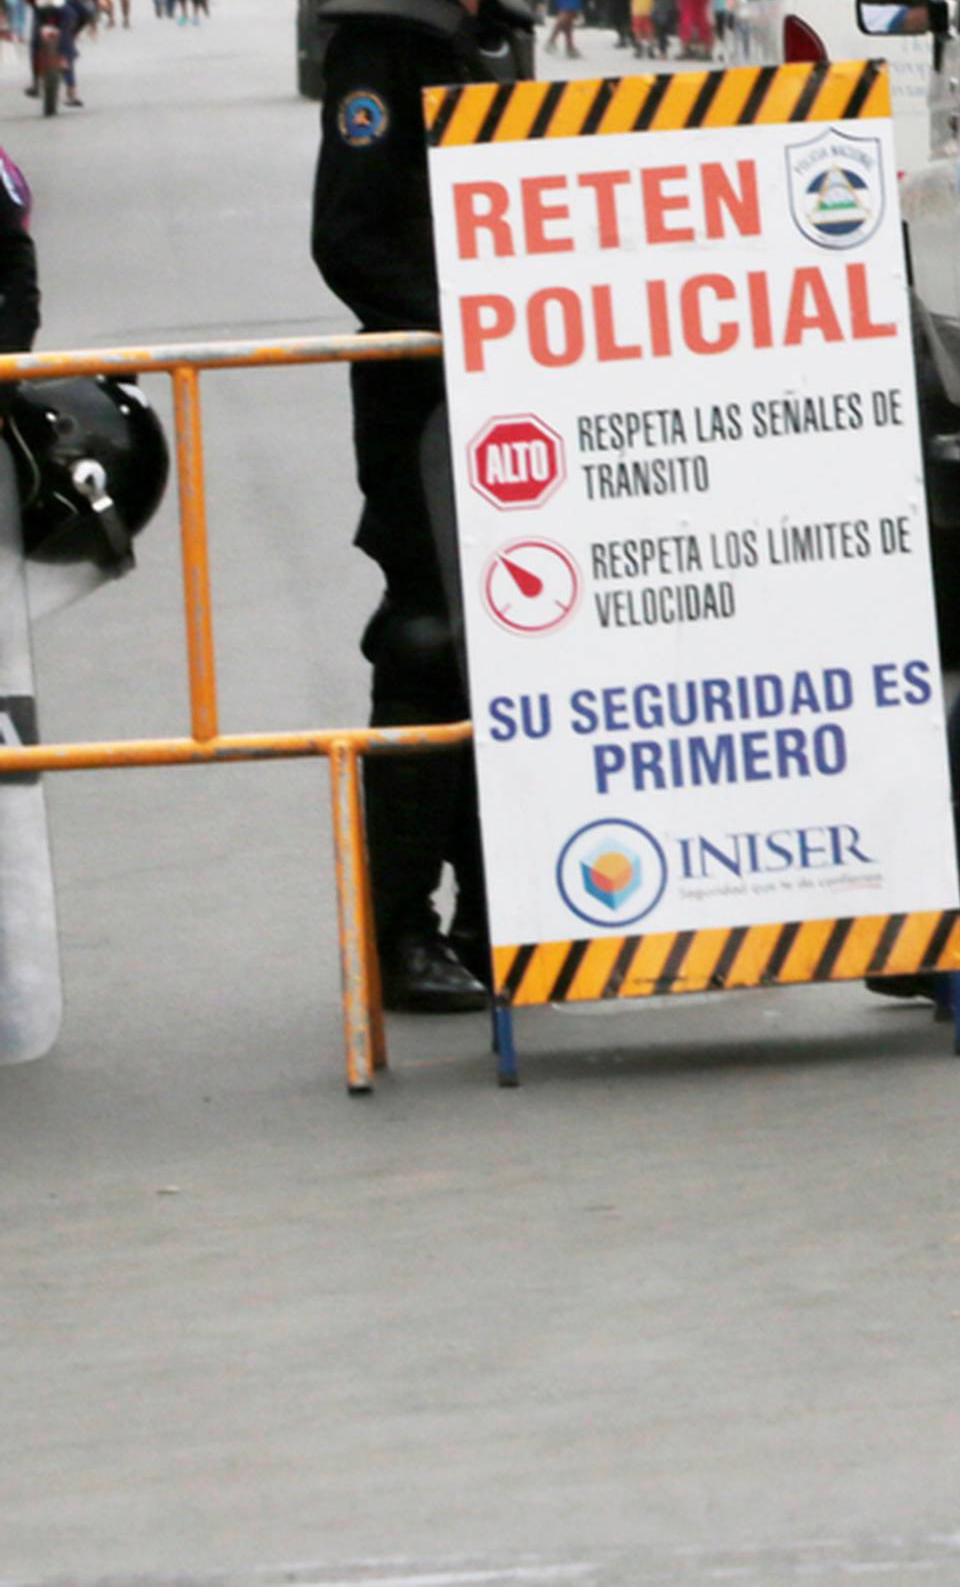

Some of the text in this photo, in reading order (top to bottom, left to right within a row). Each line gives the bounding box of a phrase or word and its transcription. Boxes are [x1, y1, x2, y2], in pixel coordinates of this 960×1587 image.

[452, 159, 762, 260] RETEN
[459, 263, 897, 373] POLICIAL
[577, 388, 904, 452] RESPETA LAS SEÑALES DE
[484, 439, 551, 484] ALTO
[581, 453, 710, 500] TRÁNSITO
[590, 515, 912, 579] RESPETA LOS LÍMITES DE
[594, 581, 736, 629] VELOCIDAD
[487, 659, 932, 743] SU SEGURIDAD ES
[592, 723, 848, 795] PRIMERO
[676, 824, 878, 879] INISER
